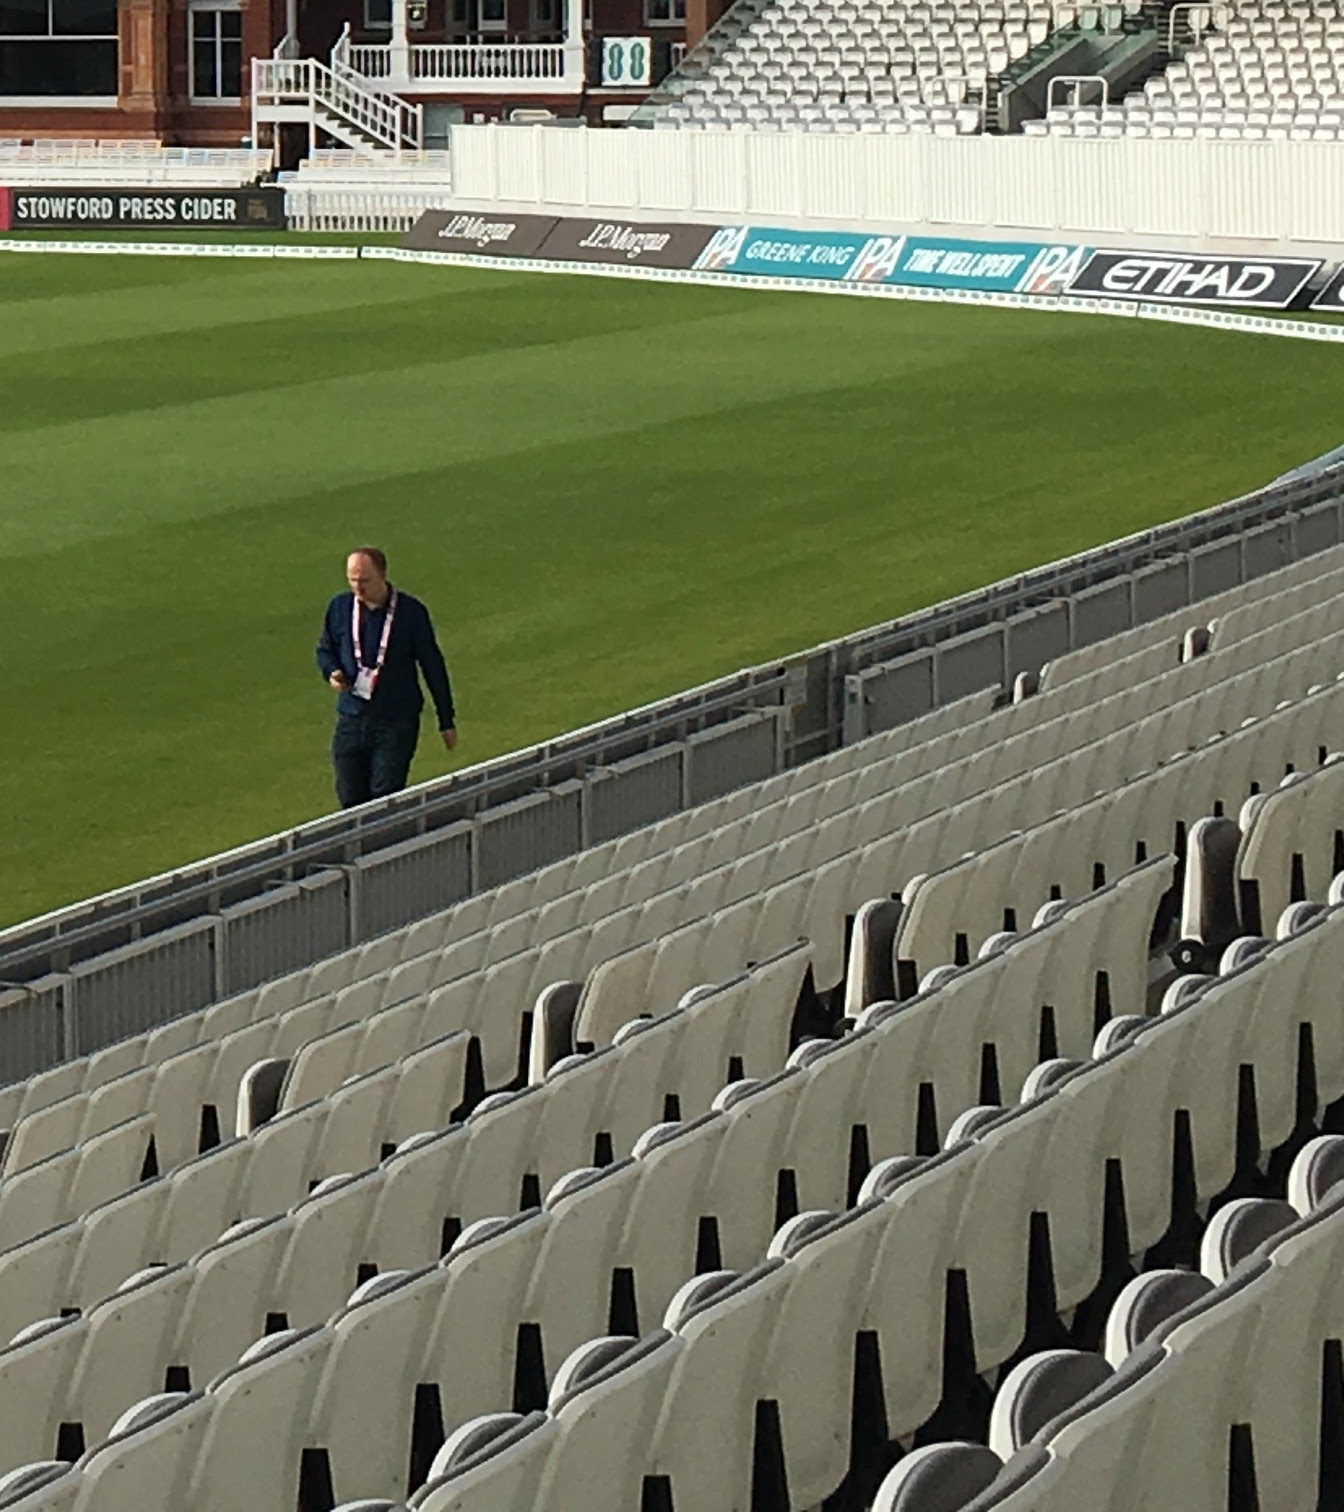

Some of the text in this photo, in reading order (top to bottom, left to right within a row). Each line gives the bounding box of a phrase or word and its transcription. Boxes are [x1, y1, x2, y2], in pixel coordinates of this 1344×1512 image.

[17, 197, 236, 220] STOWFORD PRESS CIDER
[691, 226, 749, 270] IPA
[745, 240, 855, 265] GREENE KING
[842, 235, 908, 280] IPA
[1014, 246, 1086, 292] IPA
[1102, 259, 1275, 298] ETIHAD
